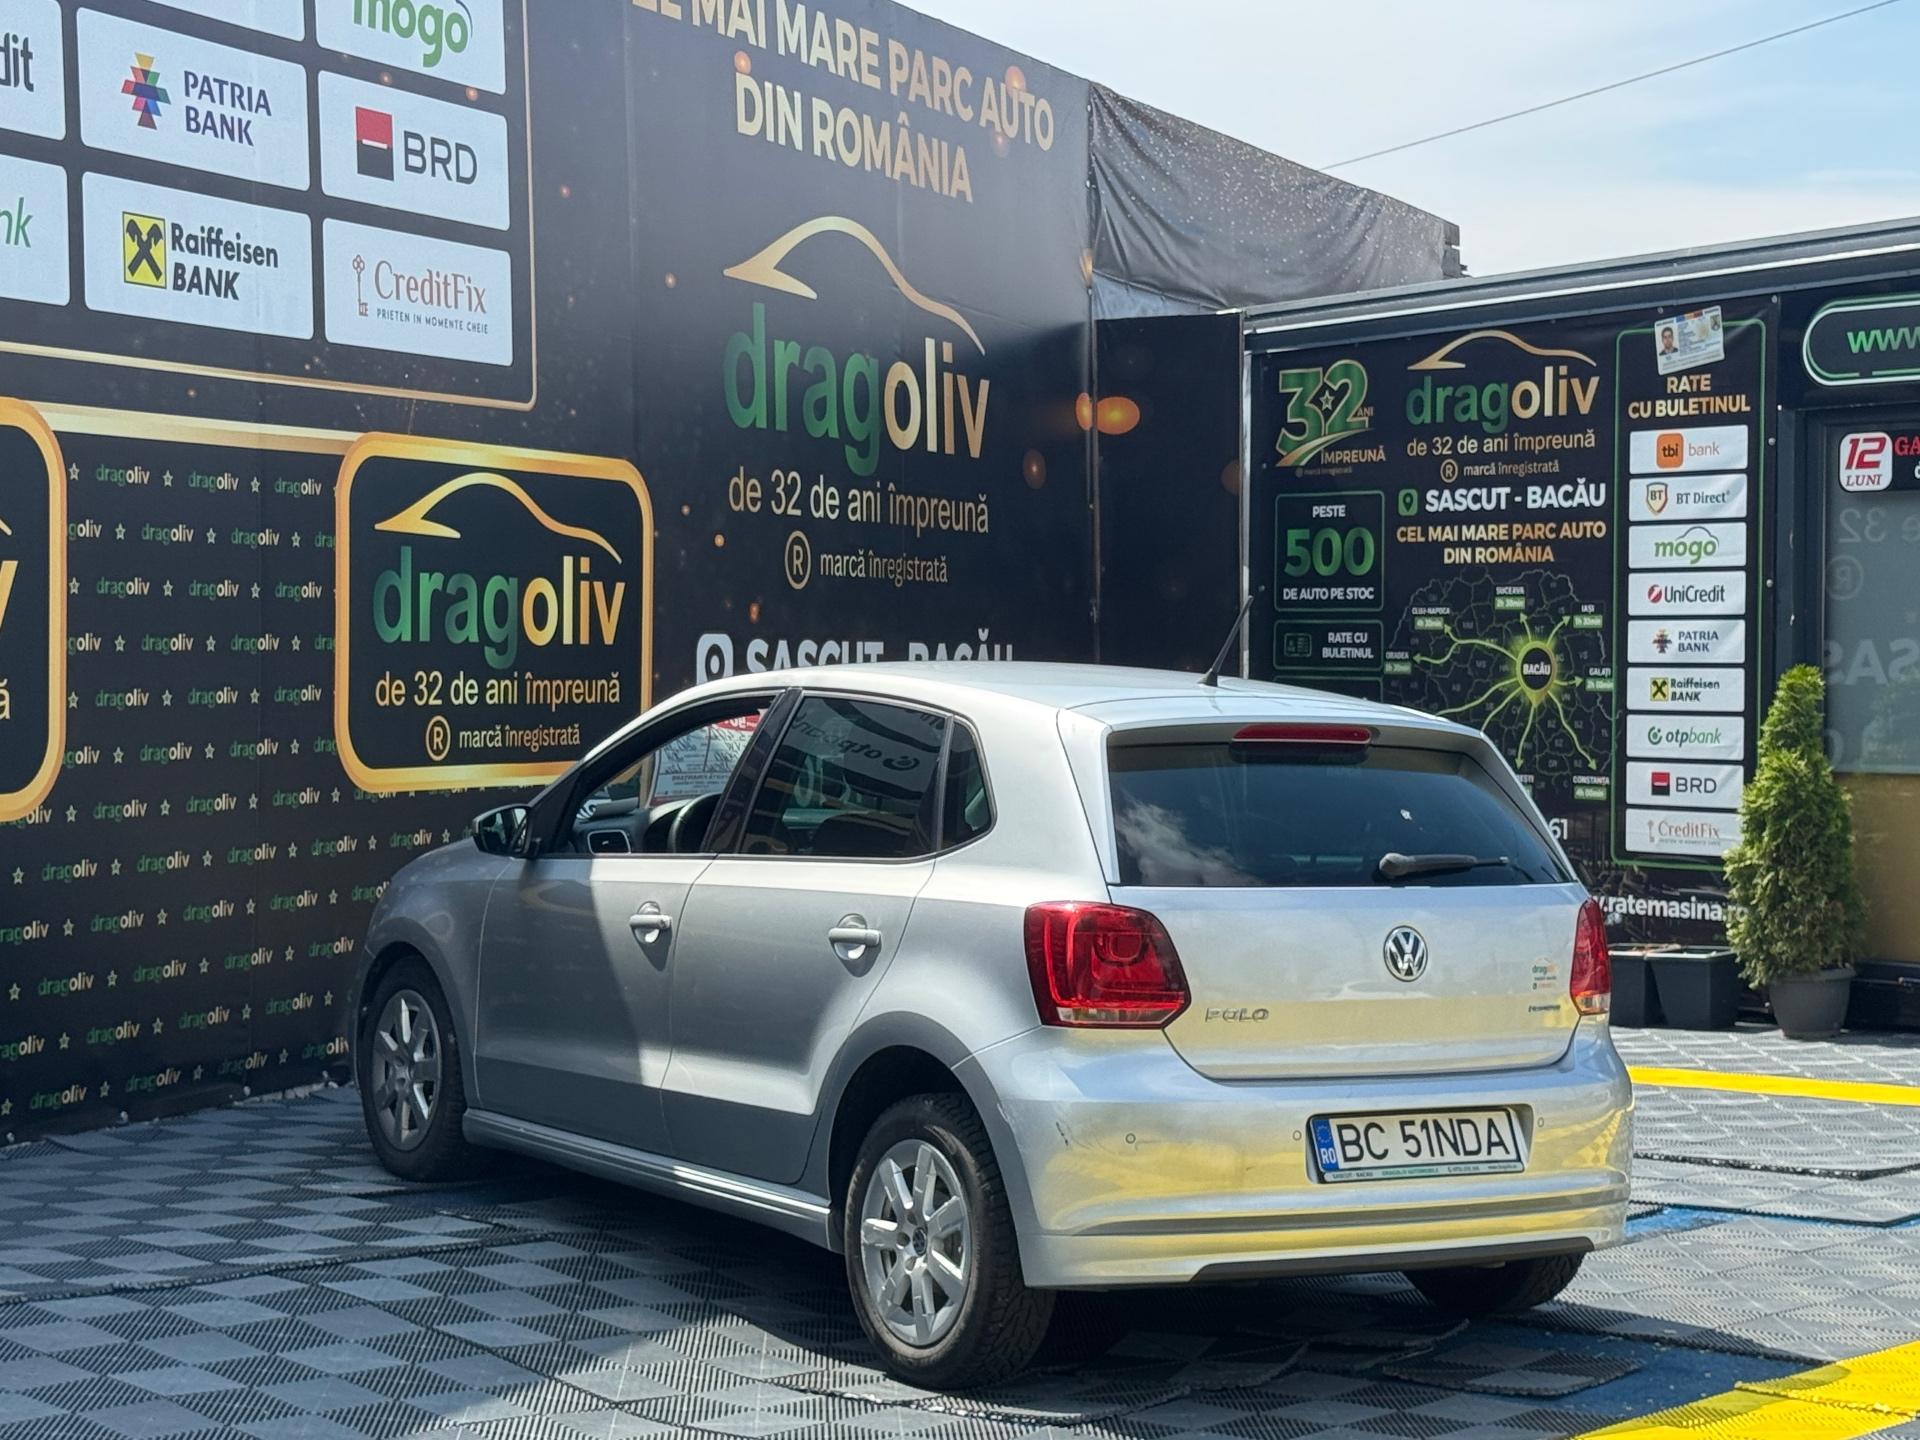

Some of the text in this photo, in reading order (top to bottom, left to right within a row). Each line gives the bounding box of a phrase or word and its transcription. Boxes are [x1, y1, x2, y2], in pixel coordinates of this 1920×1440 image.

[353, 0, 469, 68] mogo
[776, 0, 881, 90] MARE
[888, 38, 973, 122] PARC
[980, 76, 1054, 151] AUTO
[184, 70, 272, 116] PATRIA
[185, 106, 254, 147] BANK
[735, 72, 973, 204] DIN ROMÂNIA
[403, 132, 478, 185] BRD
[171, 222, 279, 269] Raiffeisen
[172, 262, 240, 301] BANK
[375, 260, 487, 314] CreditFix
[377, 308, 489, 334] PRIETEN IN MOMENTE CHEIE
[722, 302, 990, 477] dragoliv
[1666, 374, 1711, 393] RATE
[1276, 359, 1368, 456] 32
[1357, 406, 1374, 417] ANI
[1406, 365, 1600, 434] dragoliv
[1628, 394, 1751, 419] CU BULETINUL
[1407, 429, 1596, 456] de 32 de ani împreună
[1662, 443, 1678, 457] tbi
[1689, 442, 1720, 456] bank
[1846, 437, 1887, 470] 12
[96, 464, 322, 497] dragoliv dragoliv dragoliv
[1463, 462, 1496, 476] marcă
[1498, 460, 1560, 477] înregistrată
[1846, 474, 1883, 486] LUNI
[728, 466, 989, 538] de 32 de ani împreună
[1425, 487, 1510, 512] SASCUT
[1527, 478, 1606, 510] BACĂU
[1650, 490, 1664, 501] BT
[1676, 493, 1691, 505] BT
[1312, 505, 1346, 518] PESTE
[68, 519, 280, 549] goliv dragoliv dragoliv
[1397, 521, 1606, 542] CEL MAI MARE PARC AUTO
[1284, 527, 1375, 577] 500
[1444, 543, 1554, 564] DIN ROMÂNIA
[1654, 539, 1717, 564] mogo
[820, 550, 866, 578] marcă
[868, 550, 948, 587] înregistrată
[96, 577, 322, 602] dragoliv dragoliv dragoliv
[1283, 587, 1375, 600] DE AUTO PE STOC
[1665, 584, 1725, 603] UniCredit
[373, 546, 625, 669] dragoliv
[68, 633, 280, 655] goliv dragoliv dragoliv
[1328, 632, 1368, 643] RATE CU
[1678, 631, 1719, 641] PATRIA
[1678, 643, 1710, 652] BANK
[1322, 647, 1374, 660] BULETINUL
[1523, 662, 1551, 675] BACĂU
[95, 684, 322, 709] dragoliv dragoliv dragoliv
[376, 671, 621, 712] de 32 de ani împreună
[1670, 678, 1720, 689] Raiffeisen
[1671, 691, 1700, 702] BANK
[459, 724, 502, 749] marcă
[505, 723, 581, 753] înregistrată
[1666, 727, 1722, 744] otpbank
[63, 738, 279, 768] goliv dragoliv dragoliv
[1675, 777, 1717, 793] BRD
[93, 787, 320, 822] dragoliv dragoliv dragoliv
[1658, 820, 1720, 839] CreditFix
[42, 859, 98, 883] dragoliv
[137, 850, 190, 874] dragoliv
[227, 844, 276, 865] dragoliv
[0, 921, 49, 945] ragoliv
[90, 910, 144, 934] dragoliv
[183, 900, 234, 923] dragoliv
[271, 890, 318, 912] dragoliv
[38, 972, 94, 997] dragoliv
[133, 960, 187, 983] dragoliv
[224, 948, 273, 971] dragoliv
[1205, 1008, 1269, 1023] POLO
[0, 1035, 45, 1061] agoliv
[1336, 1122, 1389, 1162] BC
[1321, 1148, 1337, 1165] RO
